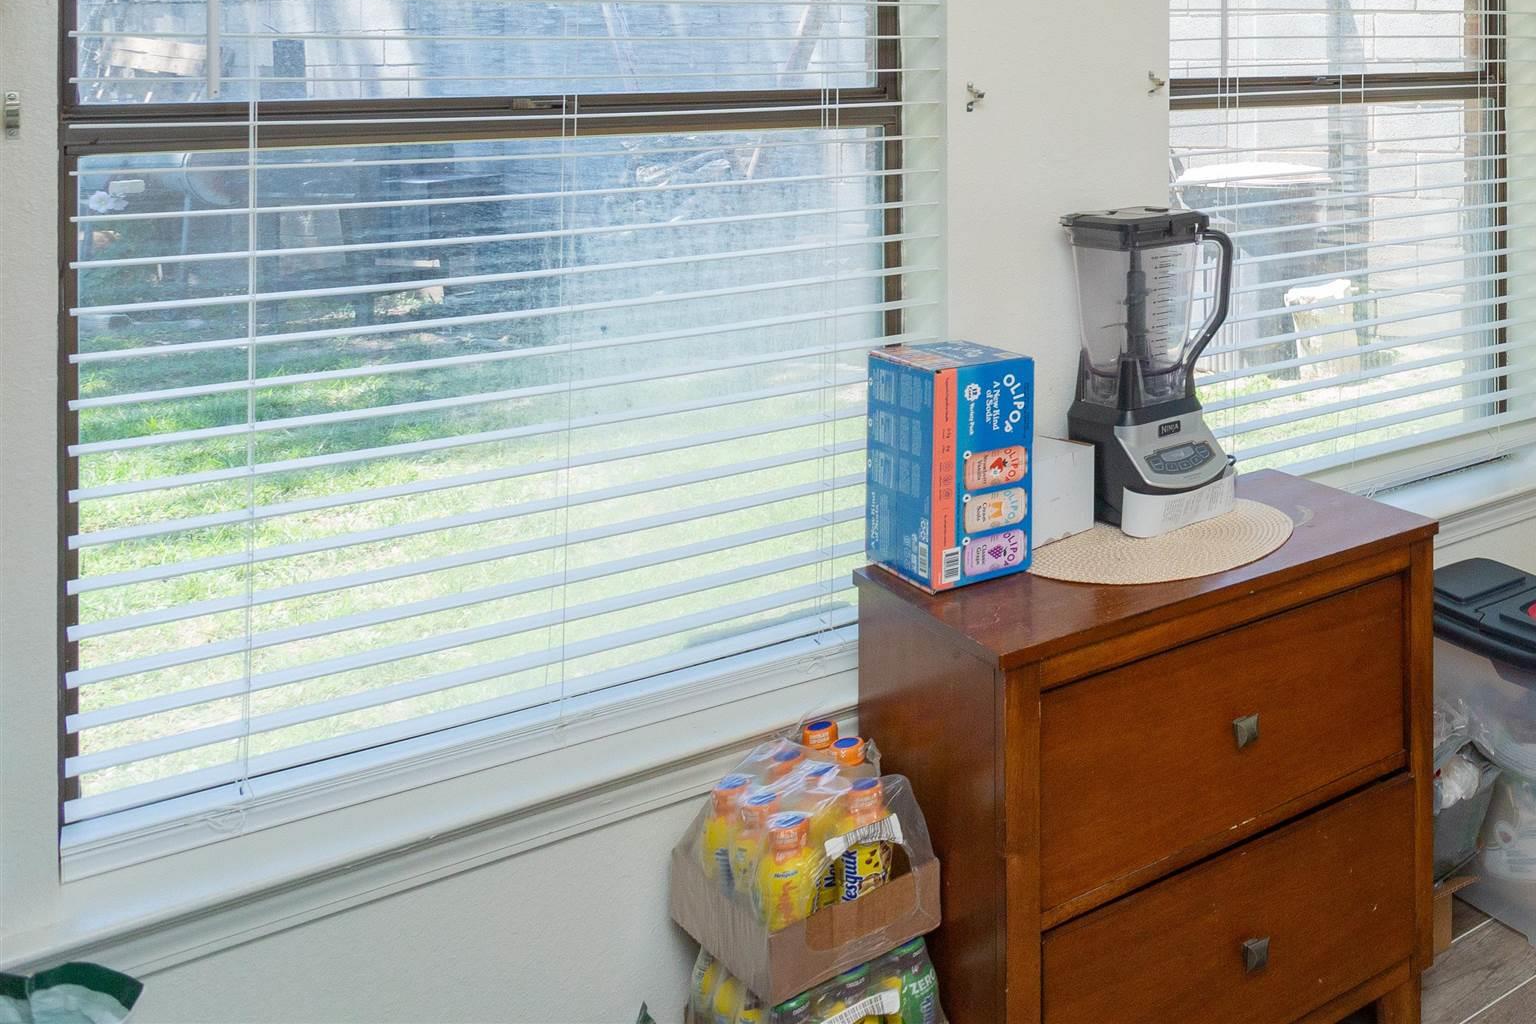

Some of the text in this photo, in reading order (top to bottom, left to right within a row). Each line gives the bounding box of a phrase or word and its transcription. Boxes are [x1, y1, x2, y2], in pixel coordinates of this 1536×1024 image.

[985, 399, 993, 422] Soda
[1003, 374, 1025, 433] OLIPOP
[992, 409, 1000, 431] Kind
[1160, 423, 1179, 435] NINJA
[841, 850, 863, 901] esquik
